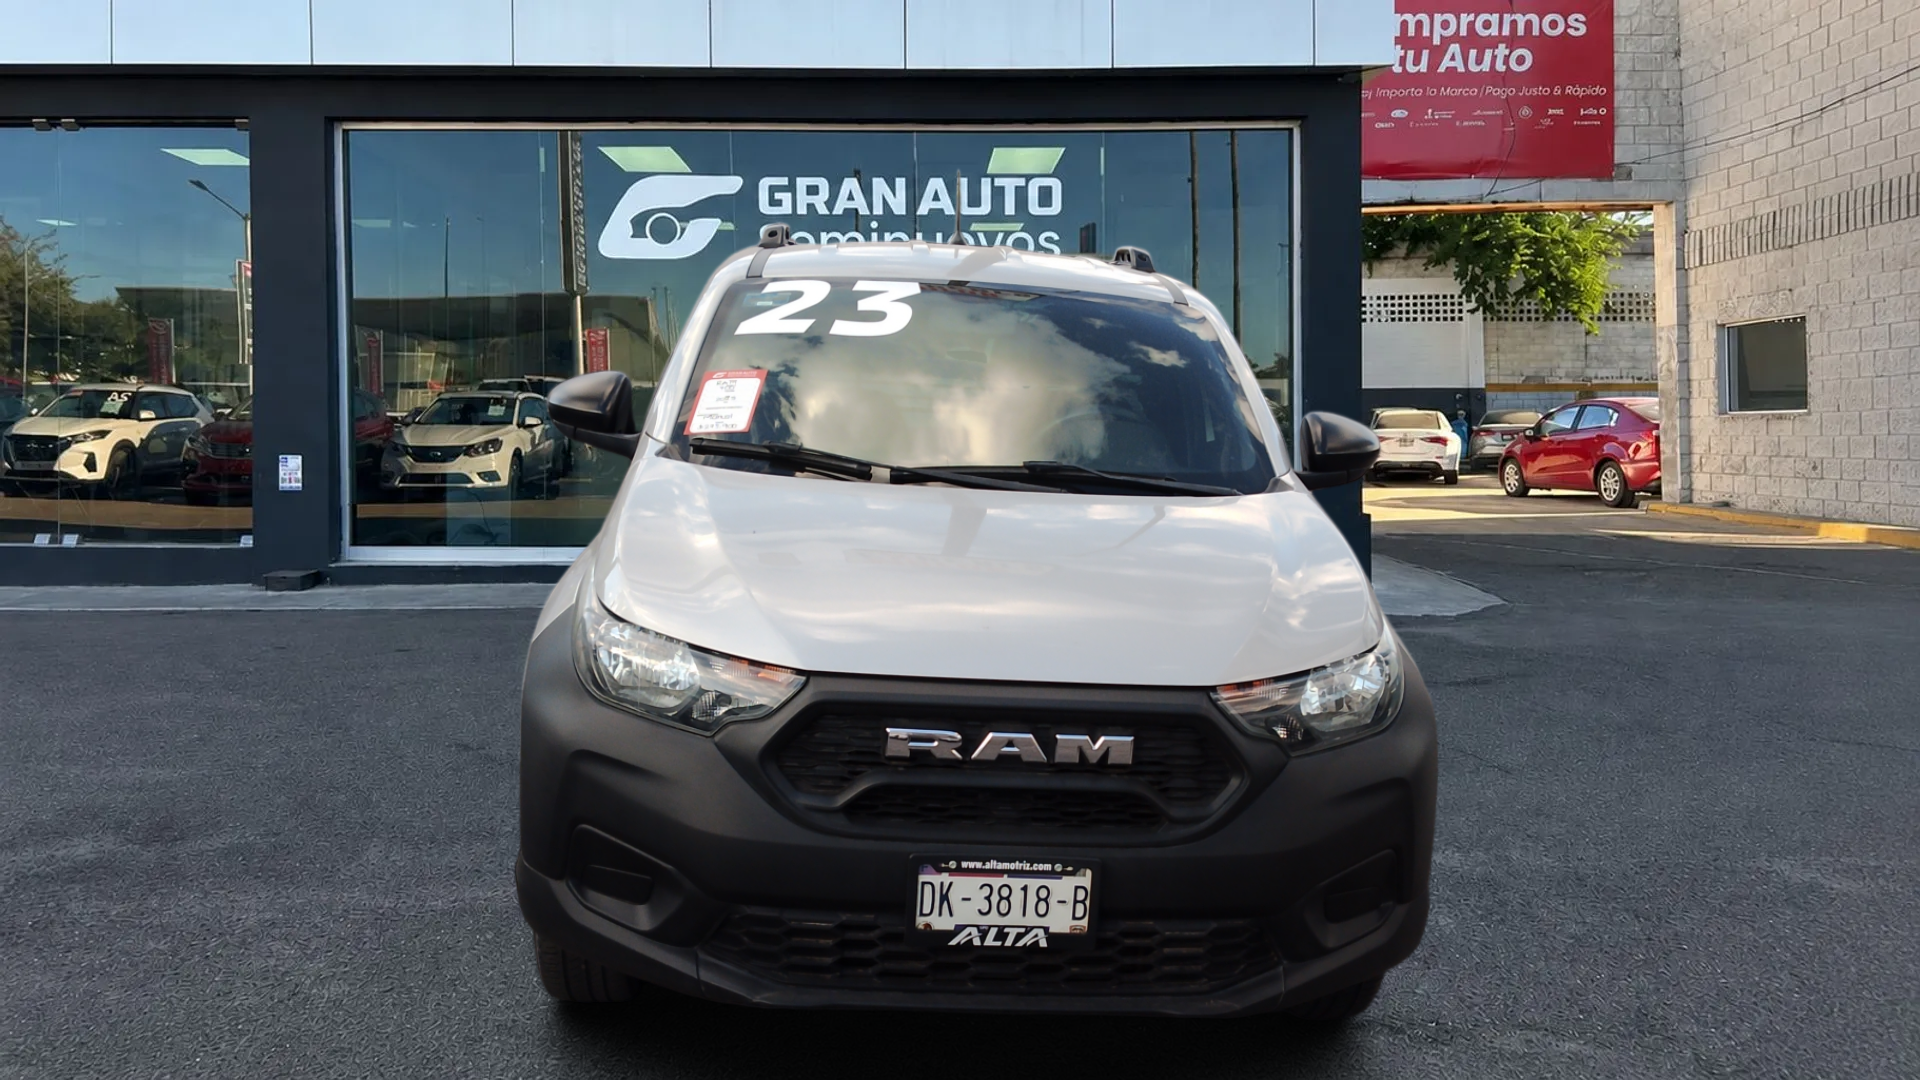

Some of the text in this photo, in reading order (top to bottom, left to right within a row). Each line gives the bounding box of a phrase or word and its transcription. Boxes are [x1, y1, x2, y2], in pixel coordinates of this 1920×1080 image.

[1394, 13, 1587, 45] mpramos
[1392, 43, 1533, 73] tu Auto
[1376, 87, 1424, 100] Importa
[1426, 86, 1437, 97] la
[1440, 86, 1478, 97] Marca
[1519, 86, 1551, 96] Justo
[758, 176, 1062, 216] GRAN AUTO
[734, 279, 922, 337] 23
[885, 727, 1135, 765] RAM
[961, 859, 1052, 872] www.altamotriz.com
[918, 880, 1089, 921] DK-3818-B
[948, 926, 1049, 948] ALTA
